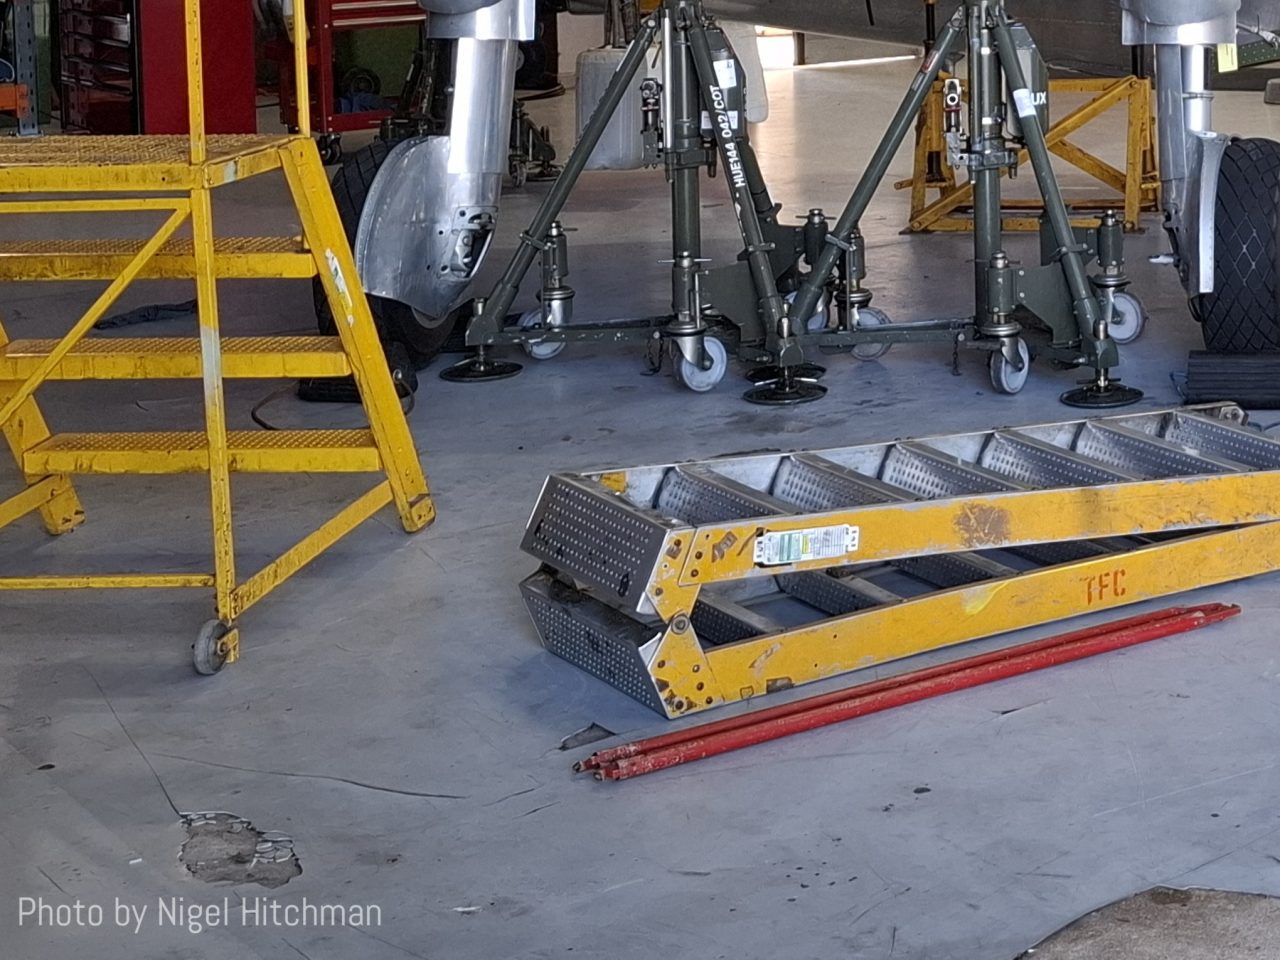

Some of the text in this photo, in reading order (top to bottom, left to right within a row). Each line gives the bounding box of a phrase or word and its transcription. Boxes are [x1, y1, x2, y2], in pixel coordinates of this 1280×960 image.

[709, 85, 732, 138] 042/COT
[725, 142, 746, 188] HUE144
[1083, 569, 1126, 606] TFC
